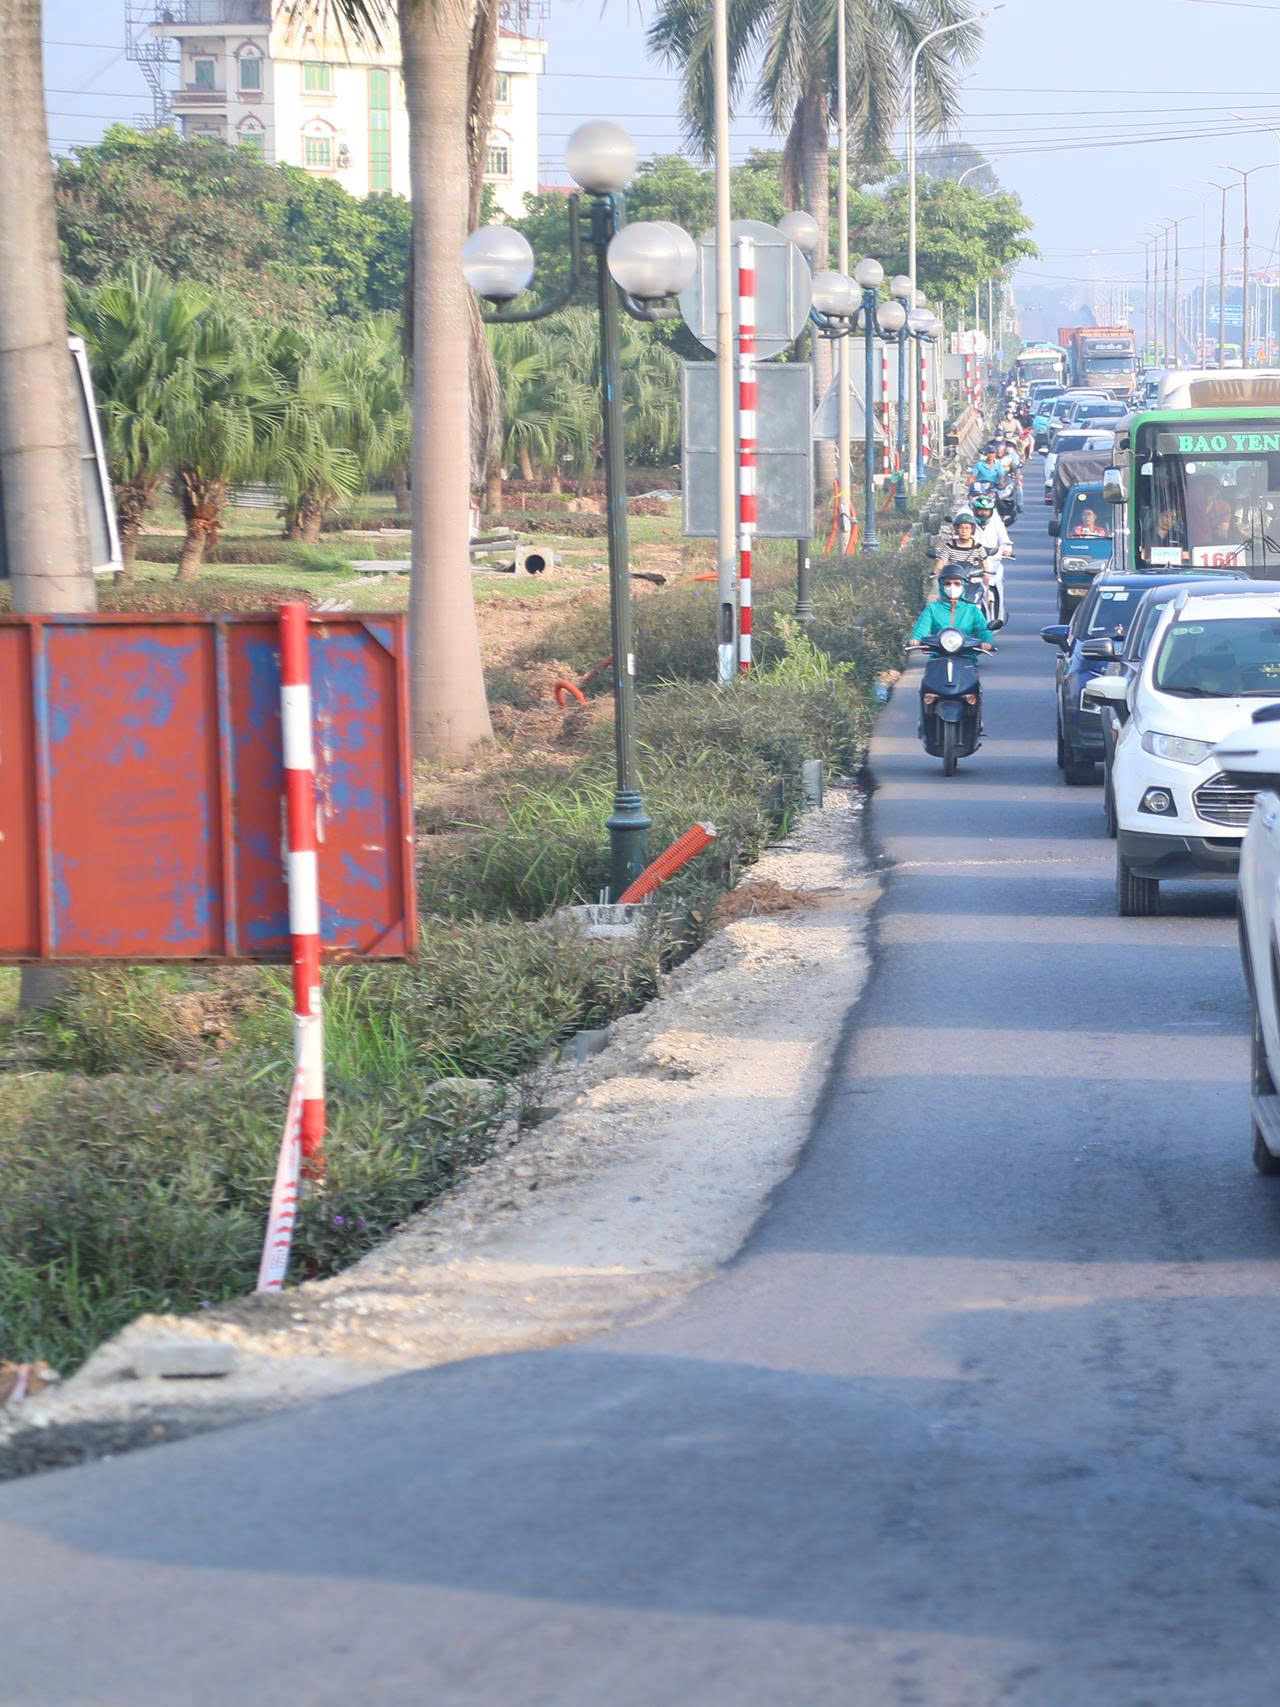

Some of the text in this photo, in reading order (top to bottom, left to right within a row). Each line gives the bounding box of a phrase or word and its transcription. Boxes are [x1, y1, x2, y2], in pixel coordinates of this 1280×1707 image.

[1178, 435, 1227, 452] BAO
[1232, 434, 1280, 451] YEN
[1200, 552, 1237, 567] 160
